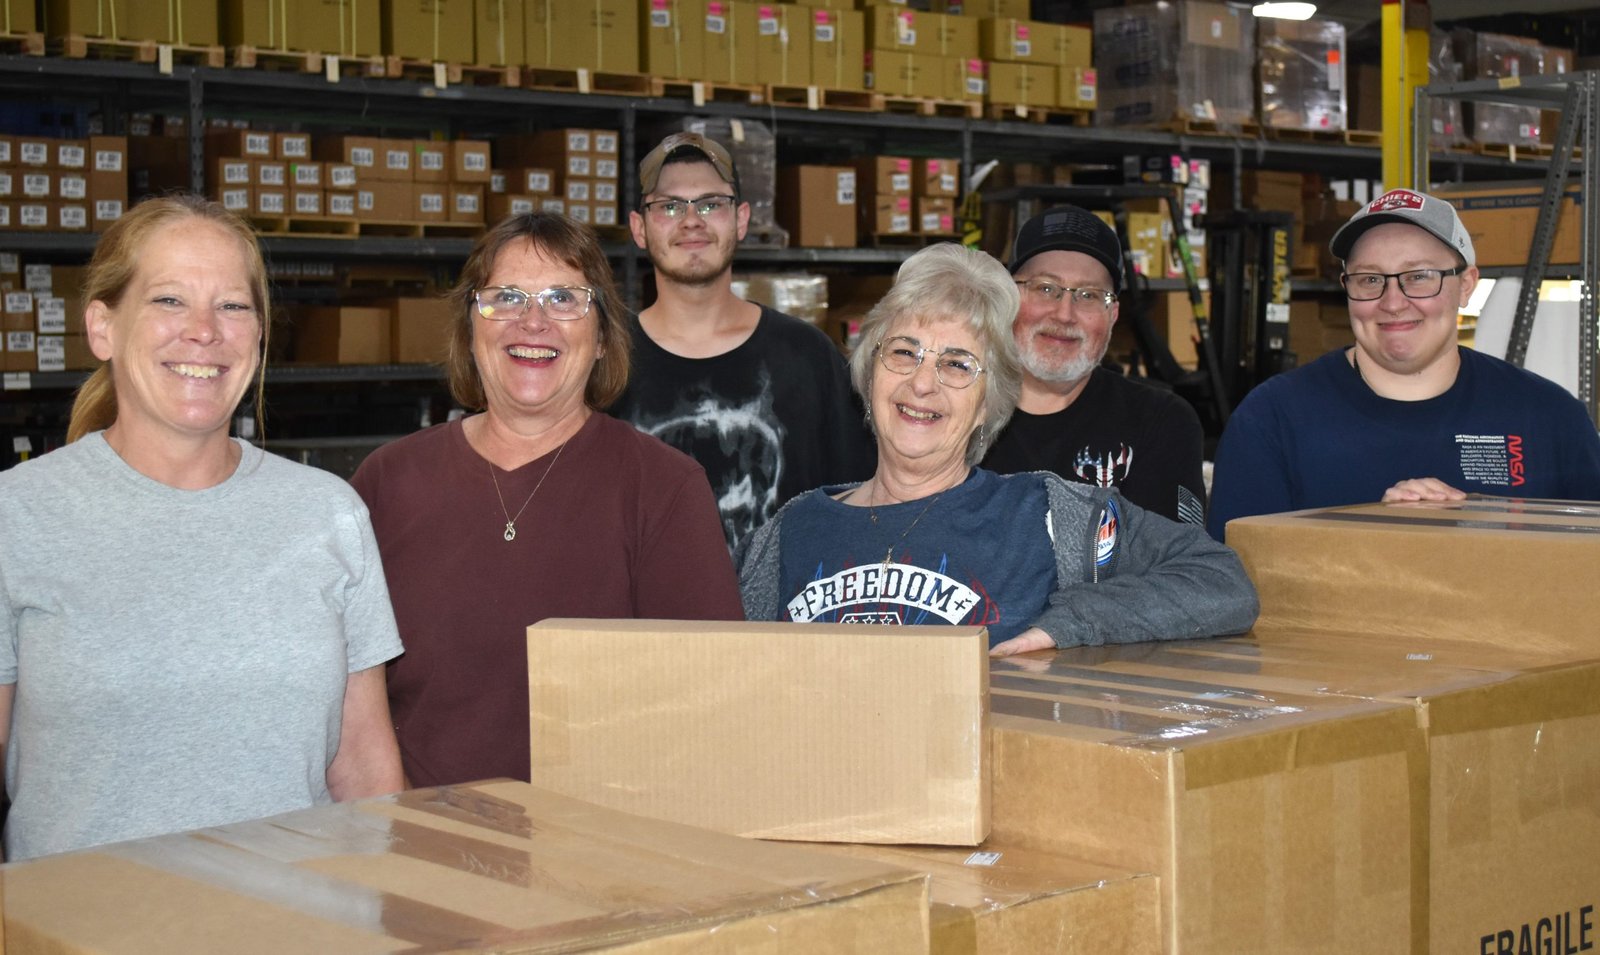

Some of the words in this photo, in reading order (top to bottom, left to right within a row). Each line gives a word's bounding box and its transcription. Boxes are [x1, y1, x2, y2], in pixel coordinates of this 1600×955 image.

[1371, 194, 1421, 208] CHIEFS
[1507, 435, 1525, 486] NASA
[801, 568, 959, 620] FREEDOM
